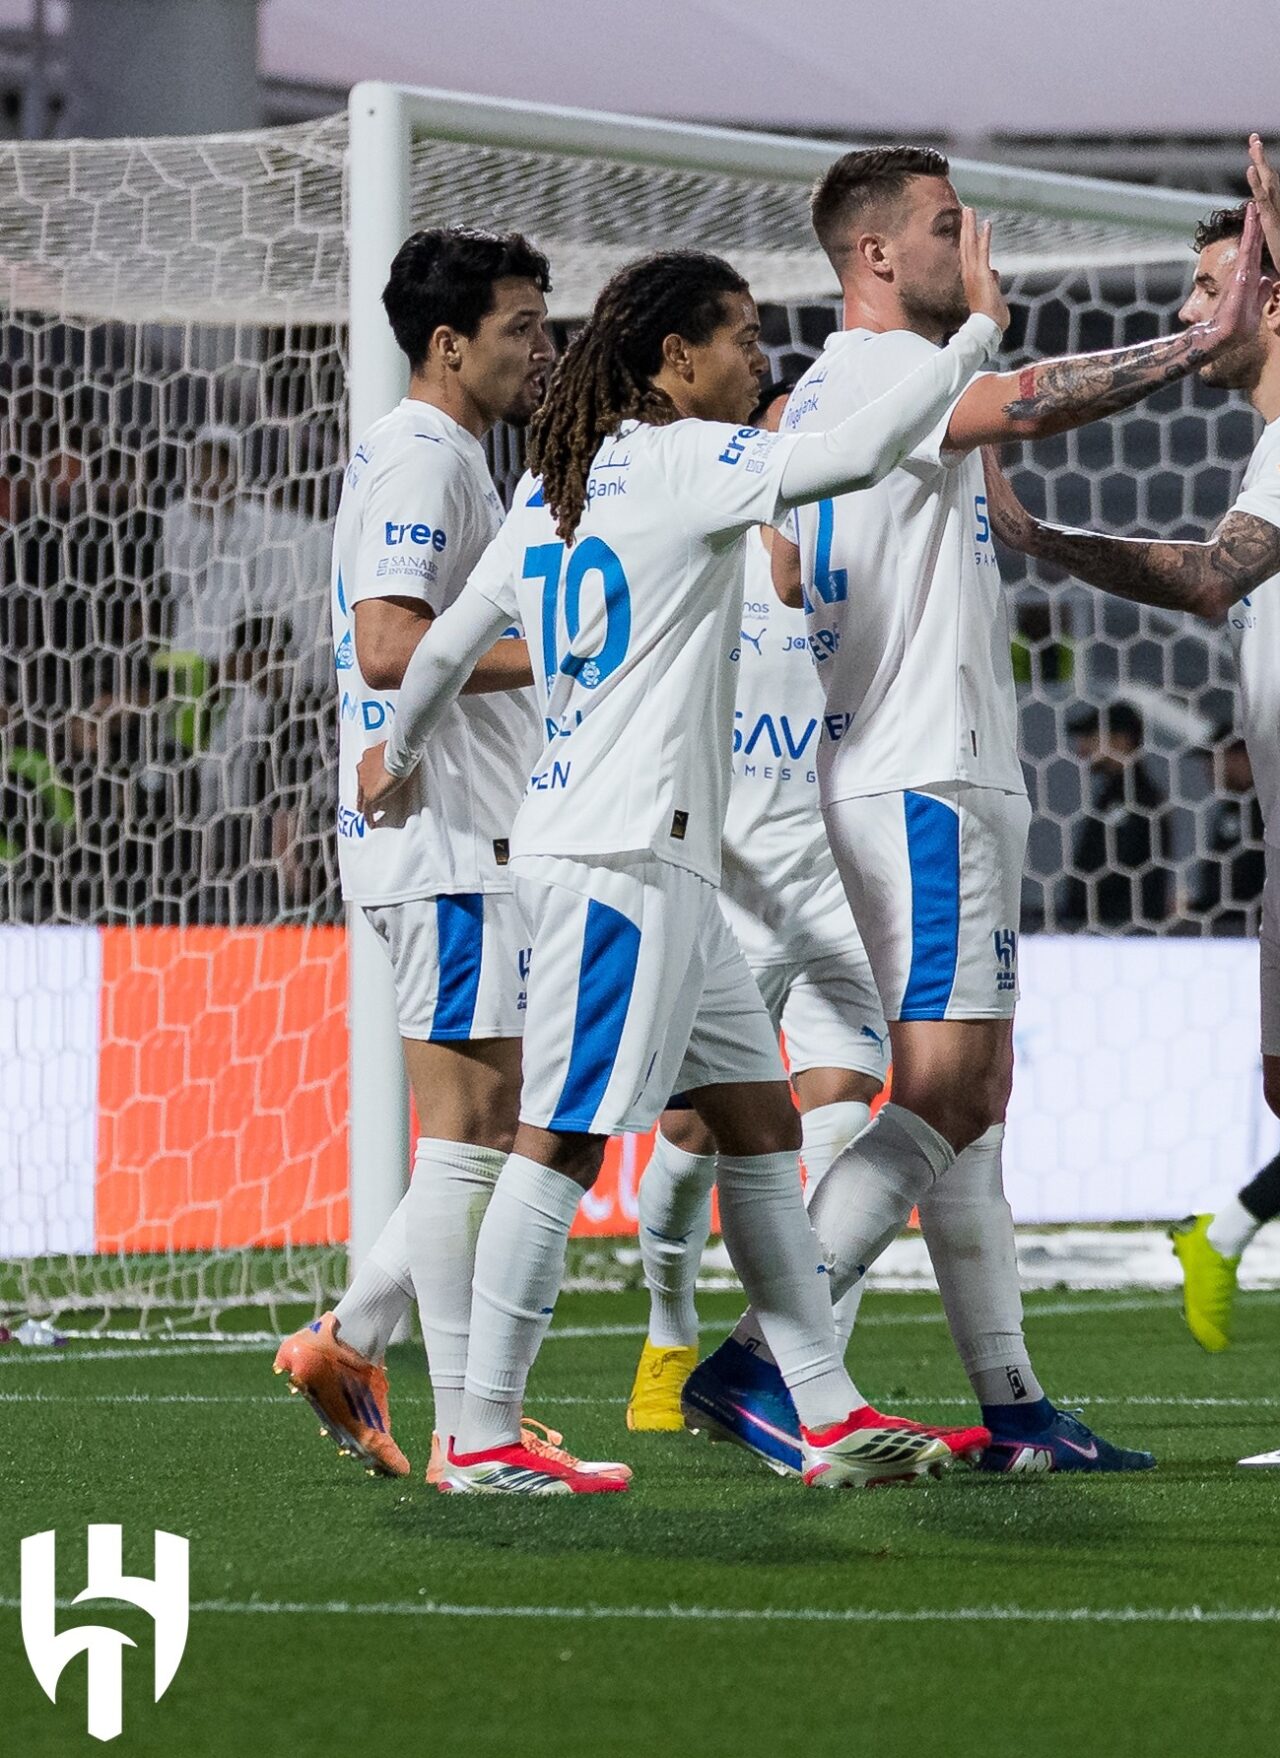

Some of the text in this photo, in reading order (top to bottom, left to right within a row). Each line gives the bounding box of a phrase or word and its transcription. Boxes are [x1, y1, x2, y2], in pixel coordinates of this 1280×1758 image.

[588, 475, 628, 500] Bank
[385, 520, 448, 553] tree
[522, 536, 632, 700] 10
